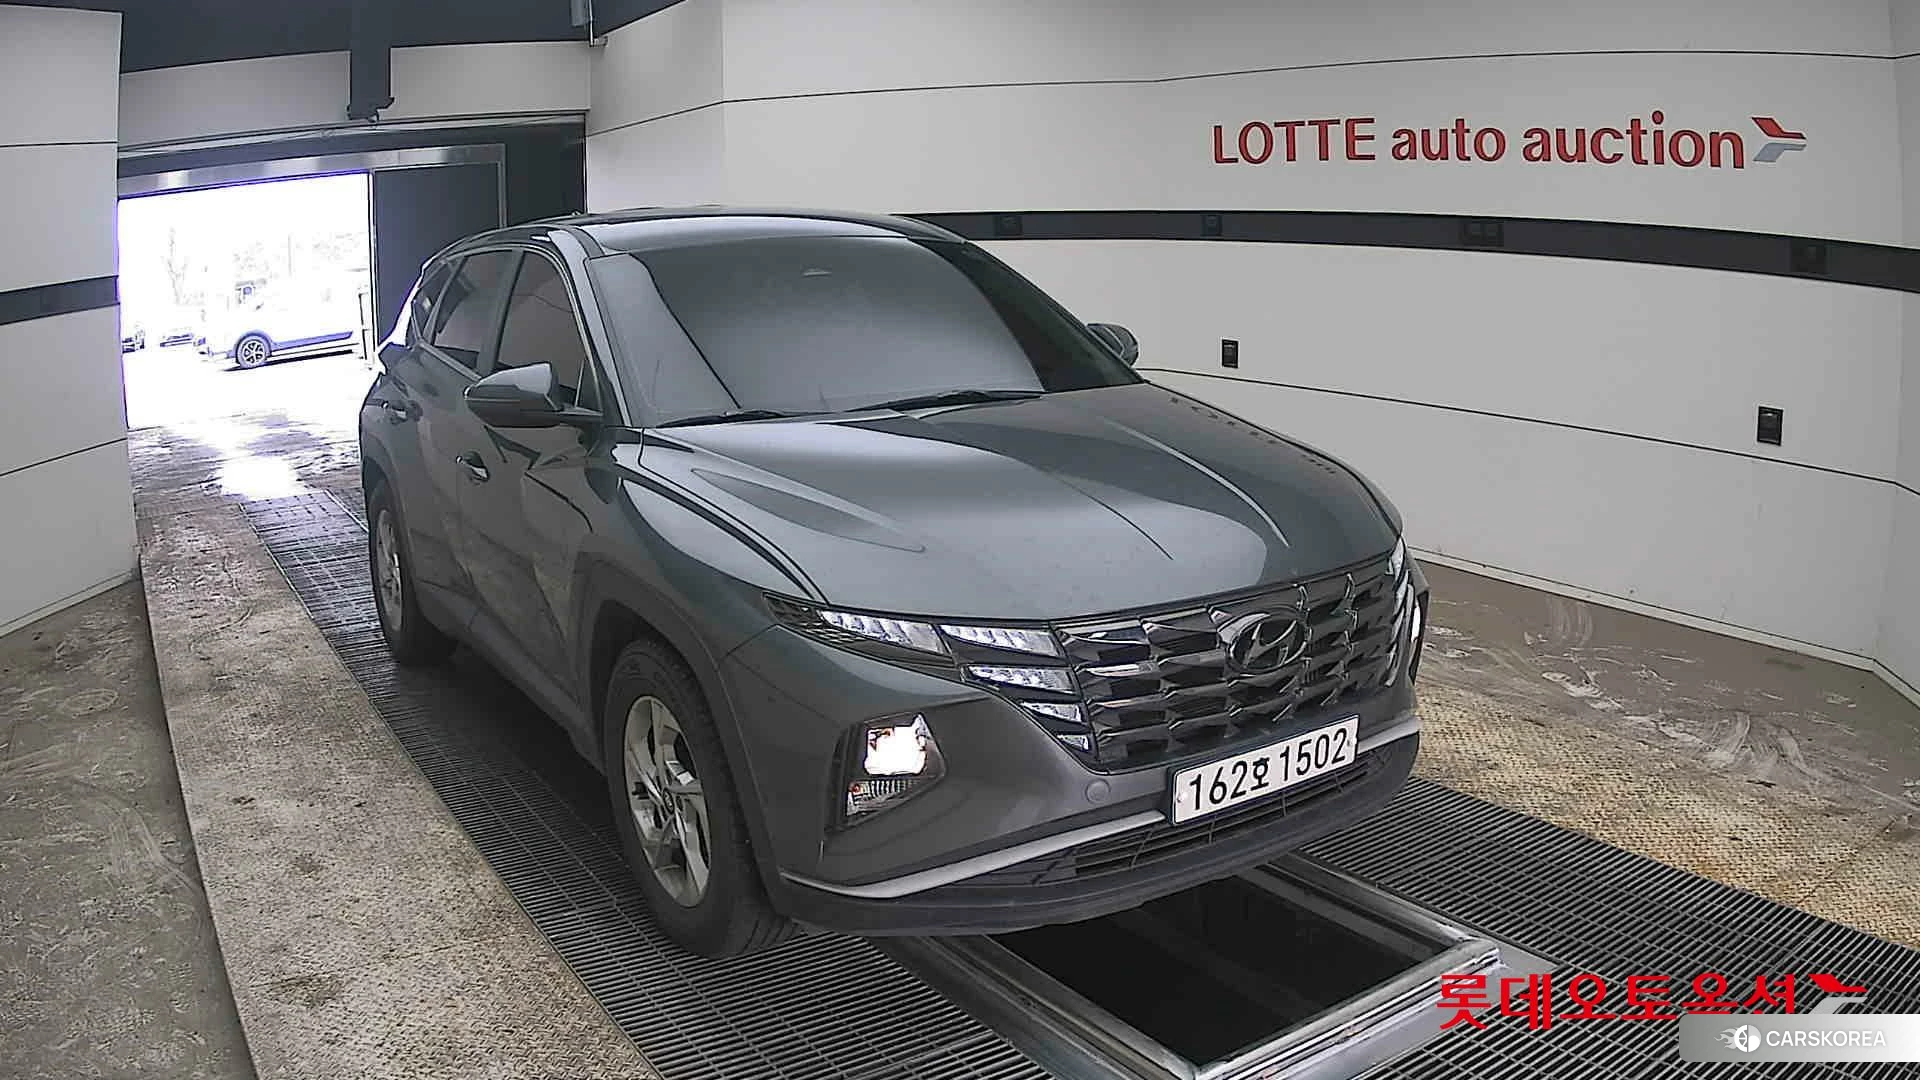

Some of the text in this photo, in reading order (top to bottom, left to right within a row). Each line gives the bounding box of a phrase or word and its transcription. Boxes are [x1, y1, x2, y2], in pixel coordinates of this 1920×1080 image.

[1213, 110, 1745, 168] LOTTE auto auction
[1189, 727, 1347, 811] 162호 1502
